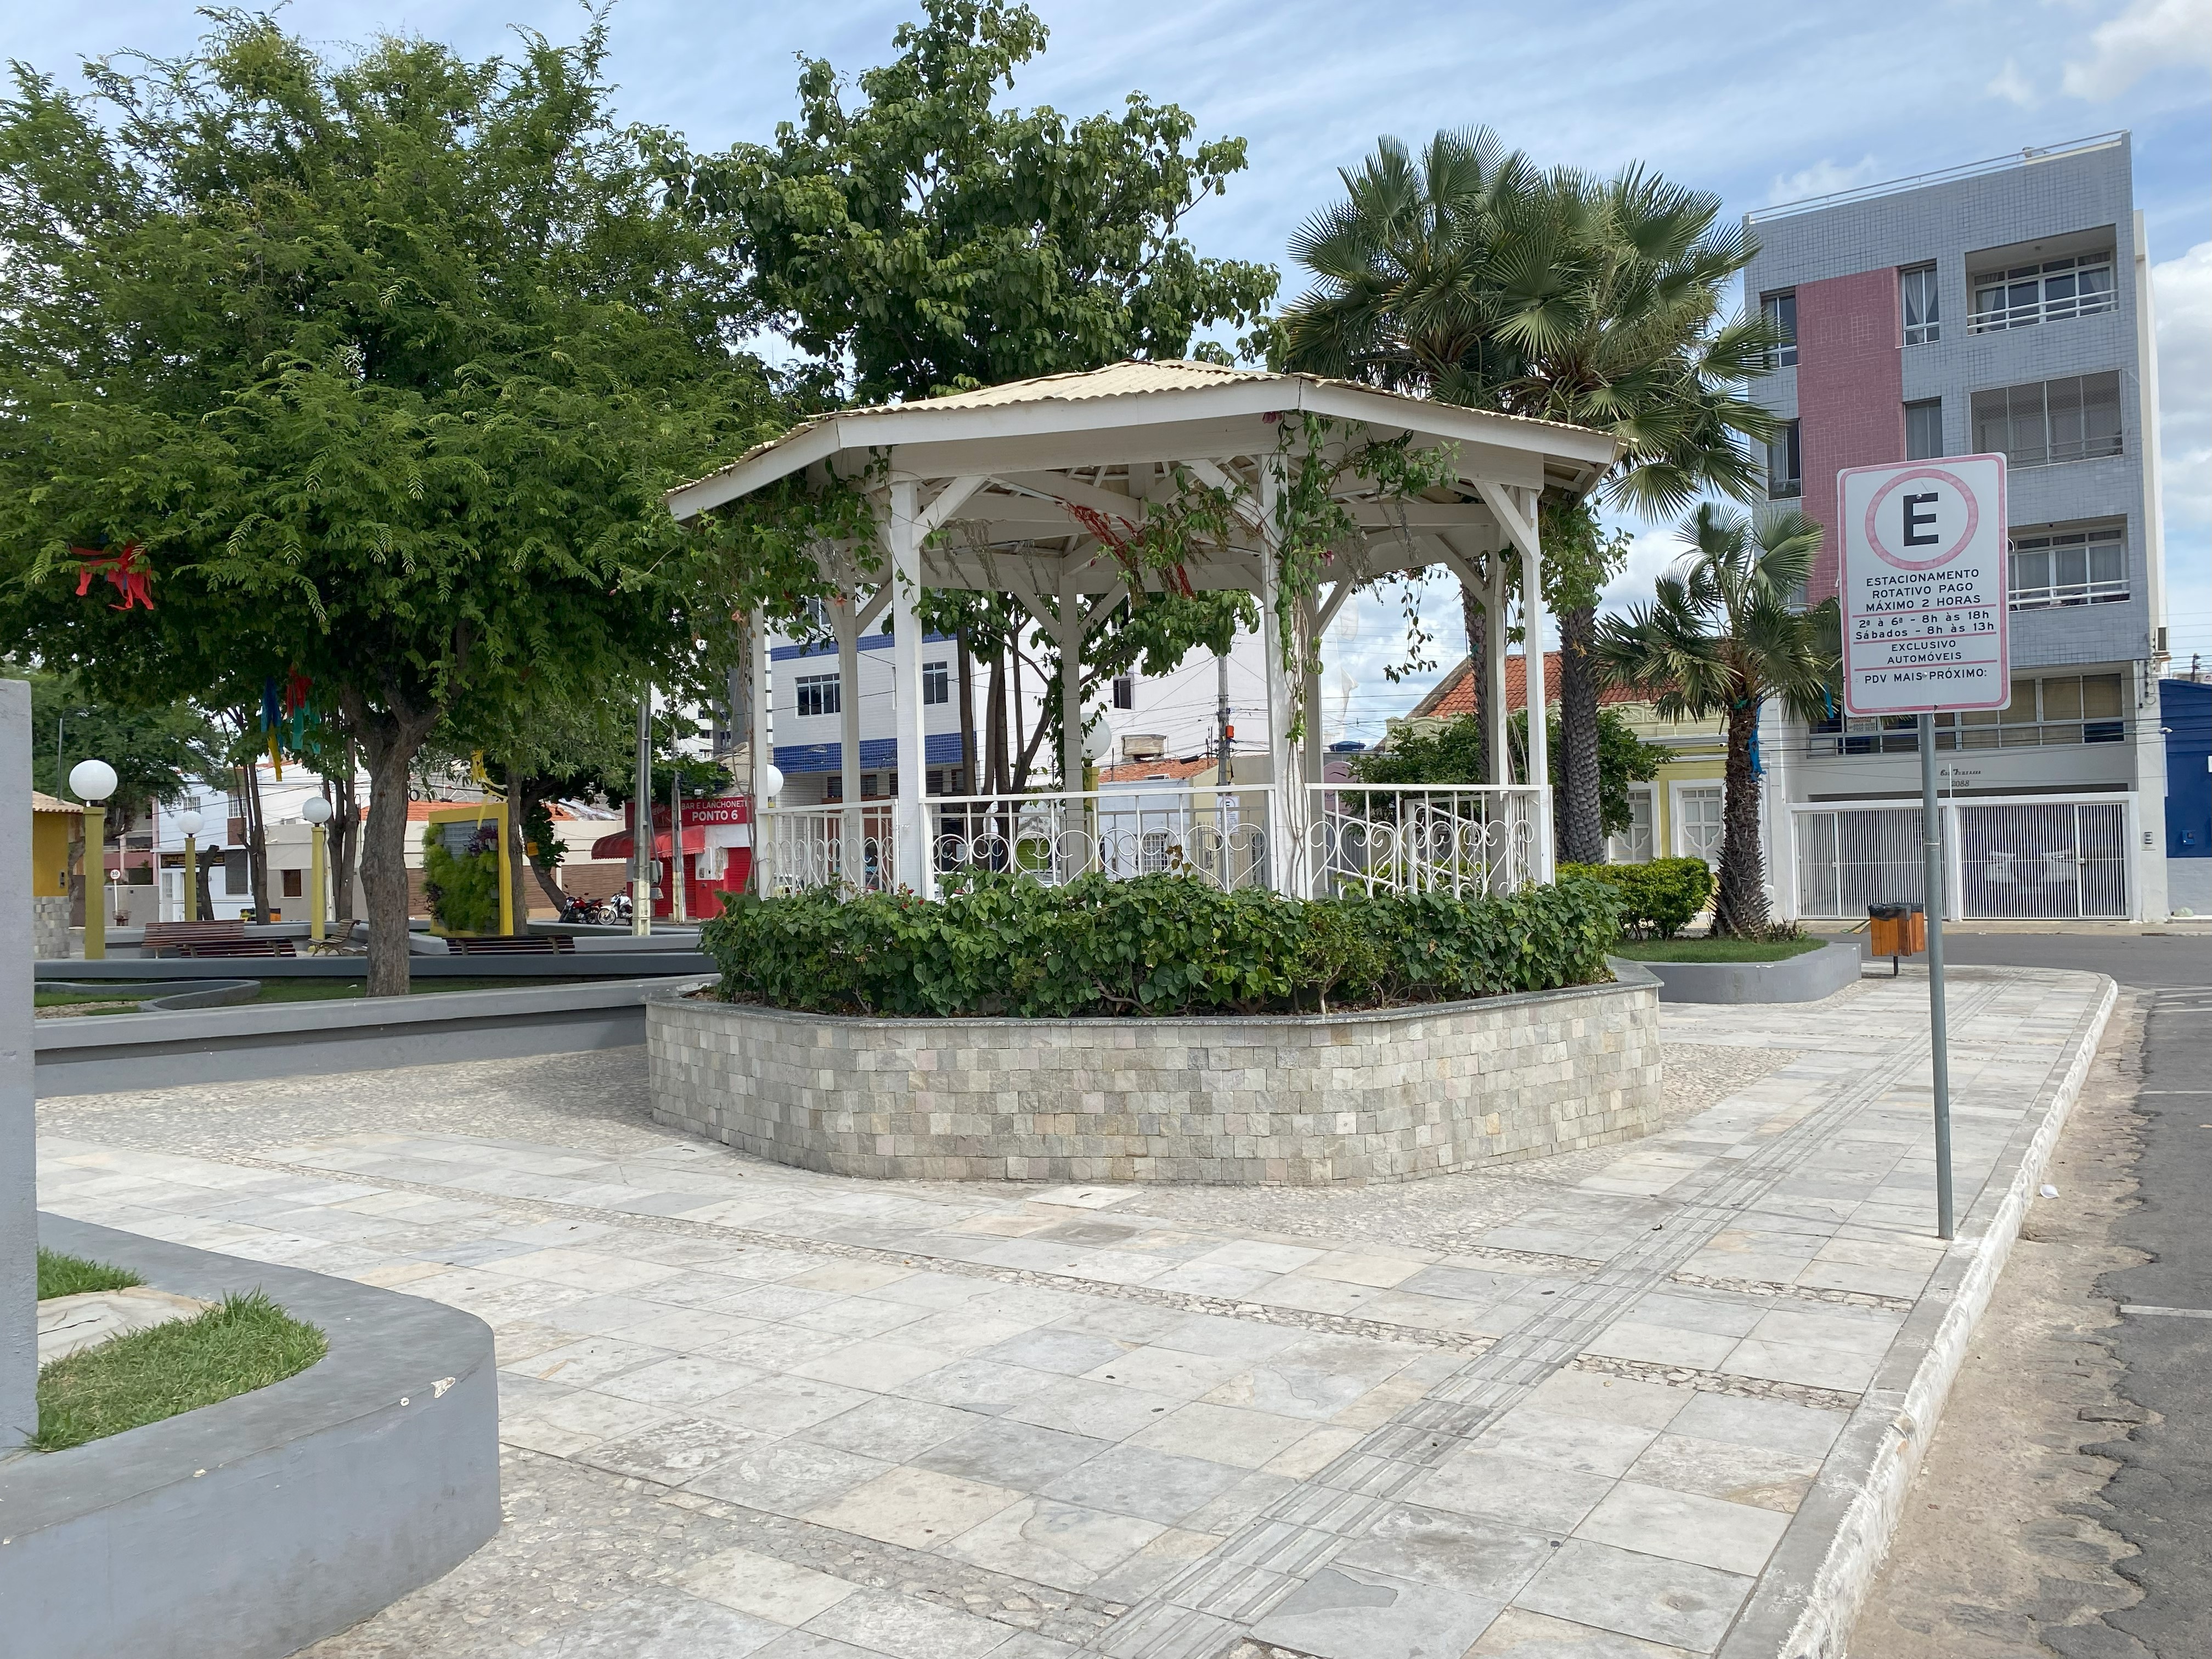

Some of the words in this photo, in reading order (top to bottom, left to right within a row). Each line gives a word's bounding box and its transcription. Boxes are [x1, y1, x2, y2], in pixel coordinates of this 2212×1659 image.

[1903, 492, 1939, 547] E
[1866, 569, 1979, 586] ESTACIONAMENTO
[1872, 586, 1932, 599] ROTATIVO
[1939, 582, 1973, 594] PAGO
[1866, 600, 1914, 612] MÁXIMO
[1922, 599, 1929, 607] 2
[1937, 595, 1981, 606] HORAS
[1878, 618, 1883, 627] à
[1922, 614, 1938, 623] 8h
[1945, 612, 1960, 622] às
[1968, 610, 1989, 619] 18h
[1855, 629, 1908, 640] Sábados
[1927, 625, 1943, 635] 8h
[1950, 623, 1965, 633] às
[1973, 622, 1994, 631] 13h
[1891, 640, 1956, 652] EXCLUSIVO
[1887, 651, 1962, 664] AUTOMÓVEIS
[1864, 674, 1887, 684] PDV
[1894, 672, 1922, 682] MAIS
[1929, 667, 1987, 680] PRÓXIMO:
[692, 810, 729, 822] PONTO
[731, 809, 738, 820] 6
